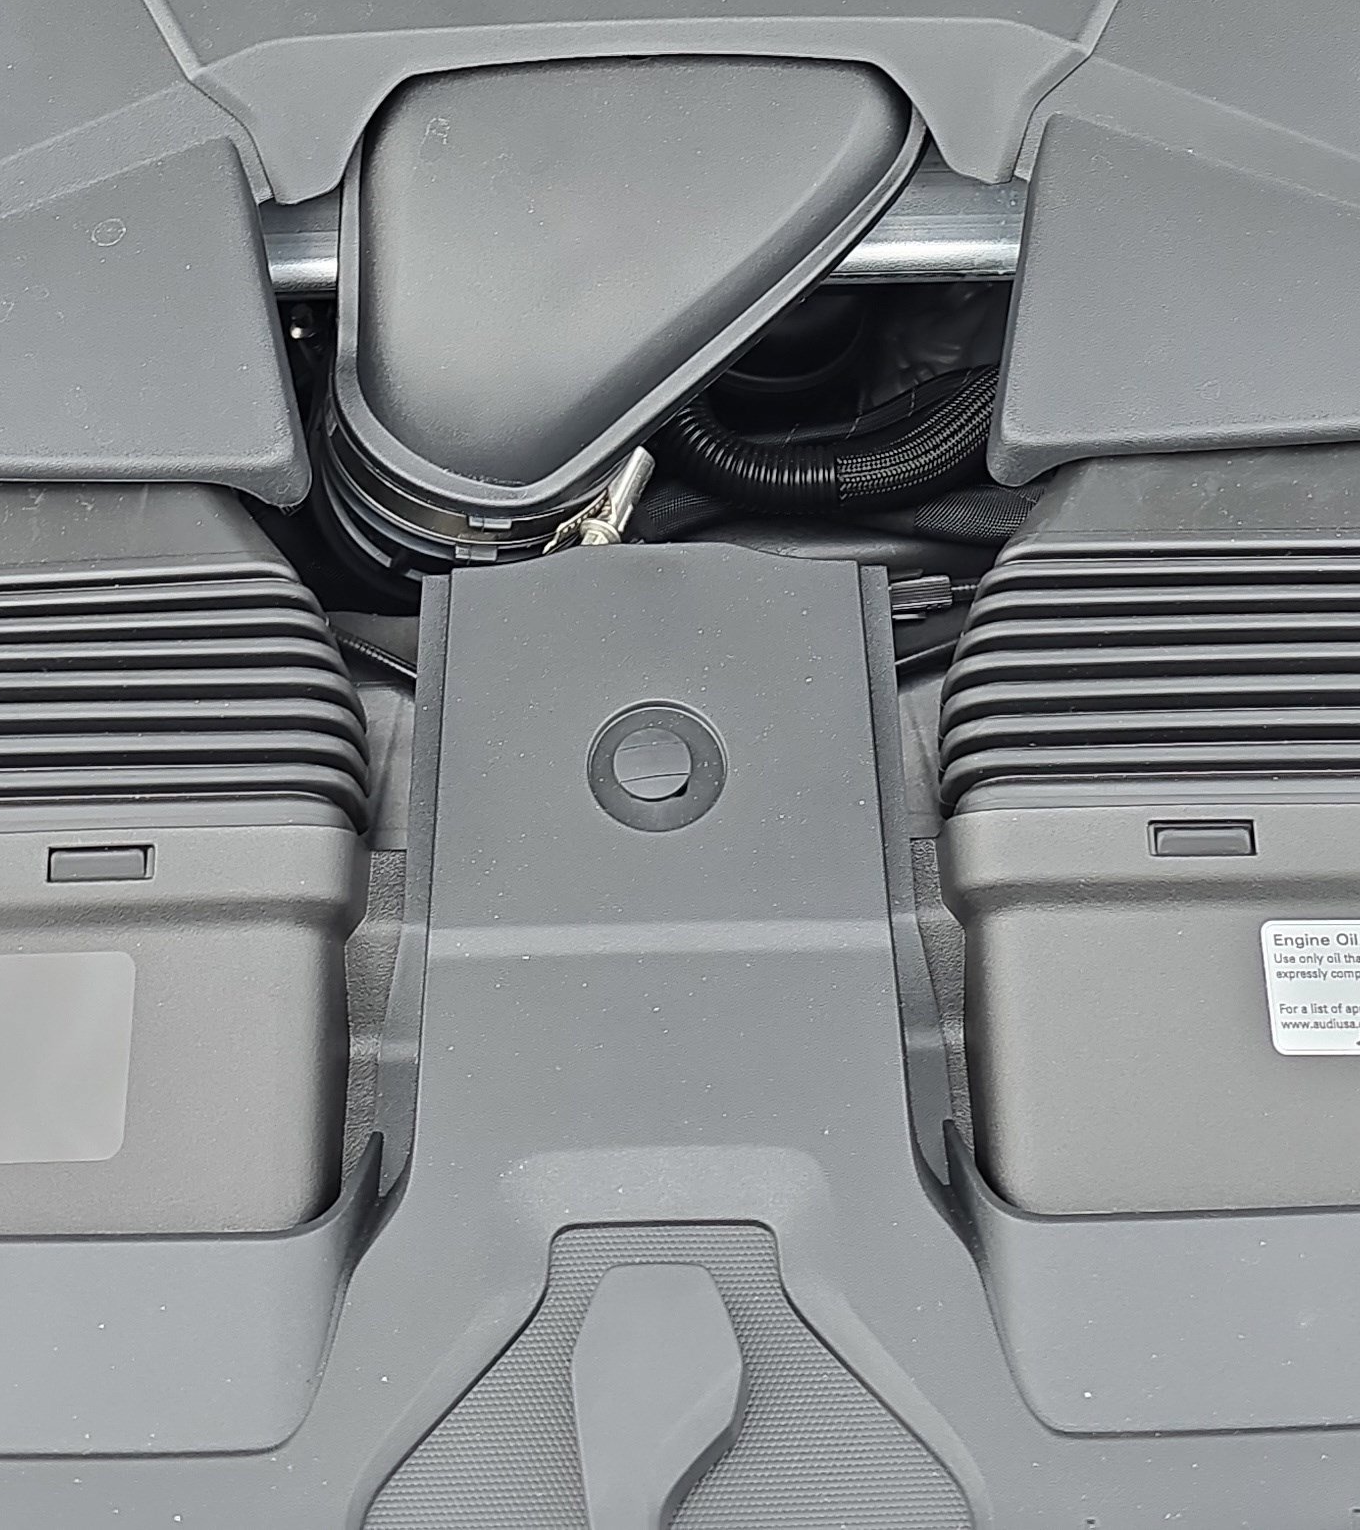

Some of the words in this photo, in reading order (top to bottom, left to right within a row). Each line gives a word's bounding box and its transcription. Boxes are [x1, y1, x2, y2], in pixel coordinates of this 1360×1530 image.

[1273, 934, 1330, 949] Engine
[1336, 933, 1358, 946] Oil
[1274, 953, 1295, 963] Use
[1298, 952, 1323, 966] only
[1327, 952, 1341, 963] oil
[1276, 968, 1327, 980] expressly
[1279, 1003, 1298, 1014] For
[1301, 1006, 1308, 1014] a
[1310, 1003, 1329, 1014] list
[1331, 1003, 1342, 1014] of
